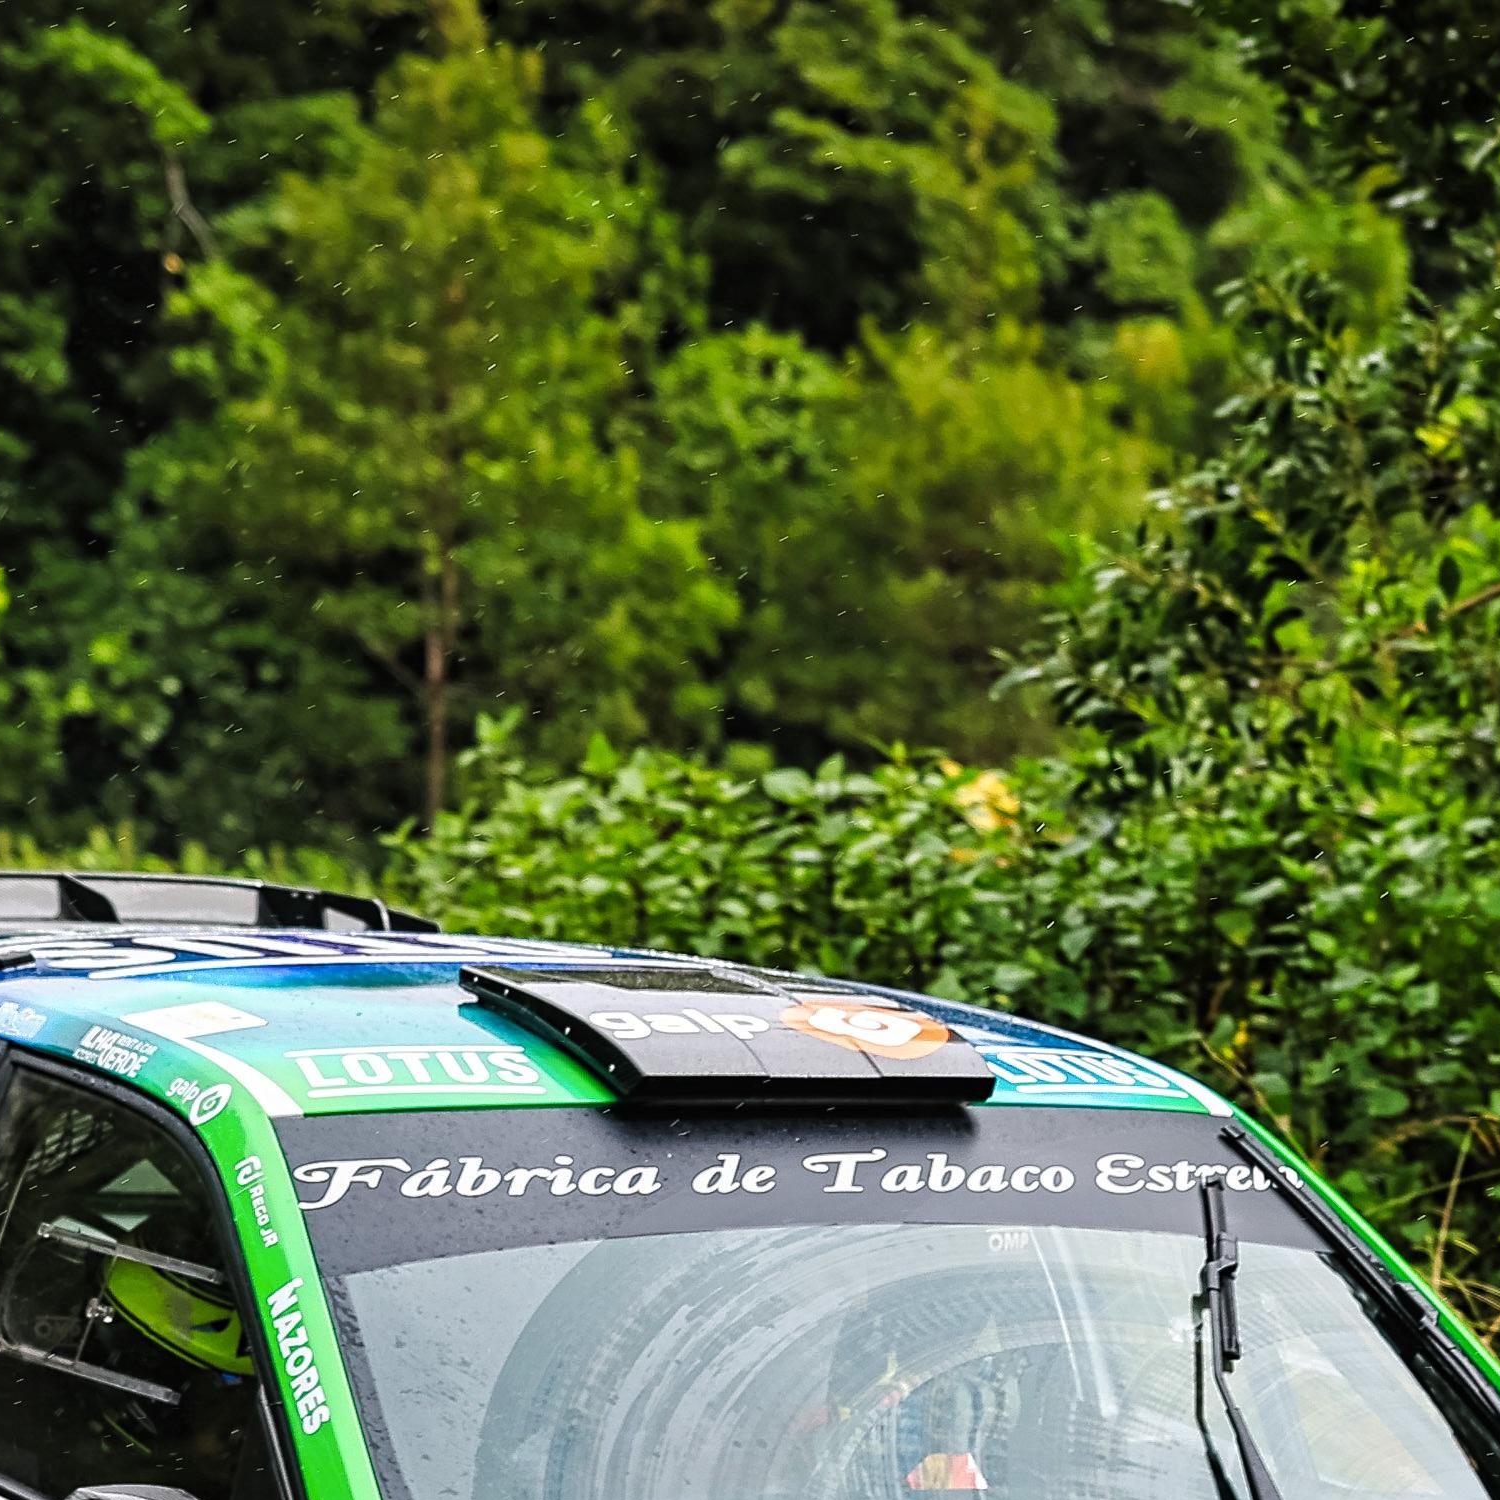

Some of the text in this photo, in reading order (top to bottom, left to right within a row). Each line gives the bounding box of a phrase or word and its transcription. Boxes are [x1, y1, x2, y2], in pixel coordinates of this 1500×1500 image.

[588, 1008, 770, 1040] galp
[297, 1049, 541, 1089] LOTUS
[164, 1077, 201, 1104] galp
[293, 1153, 663, 1211] Fábrica
[691, 1153, 778, 1196] de
[806, 1147, 1076, 1195] Tabaco
